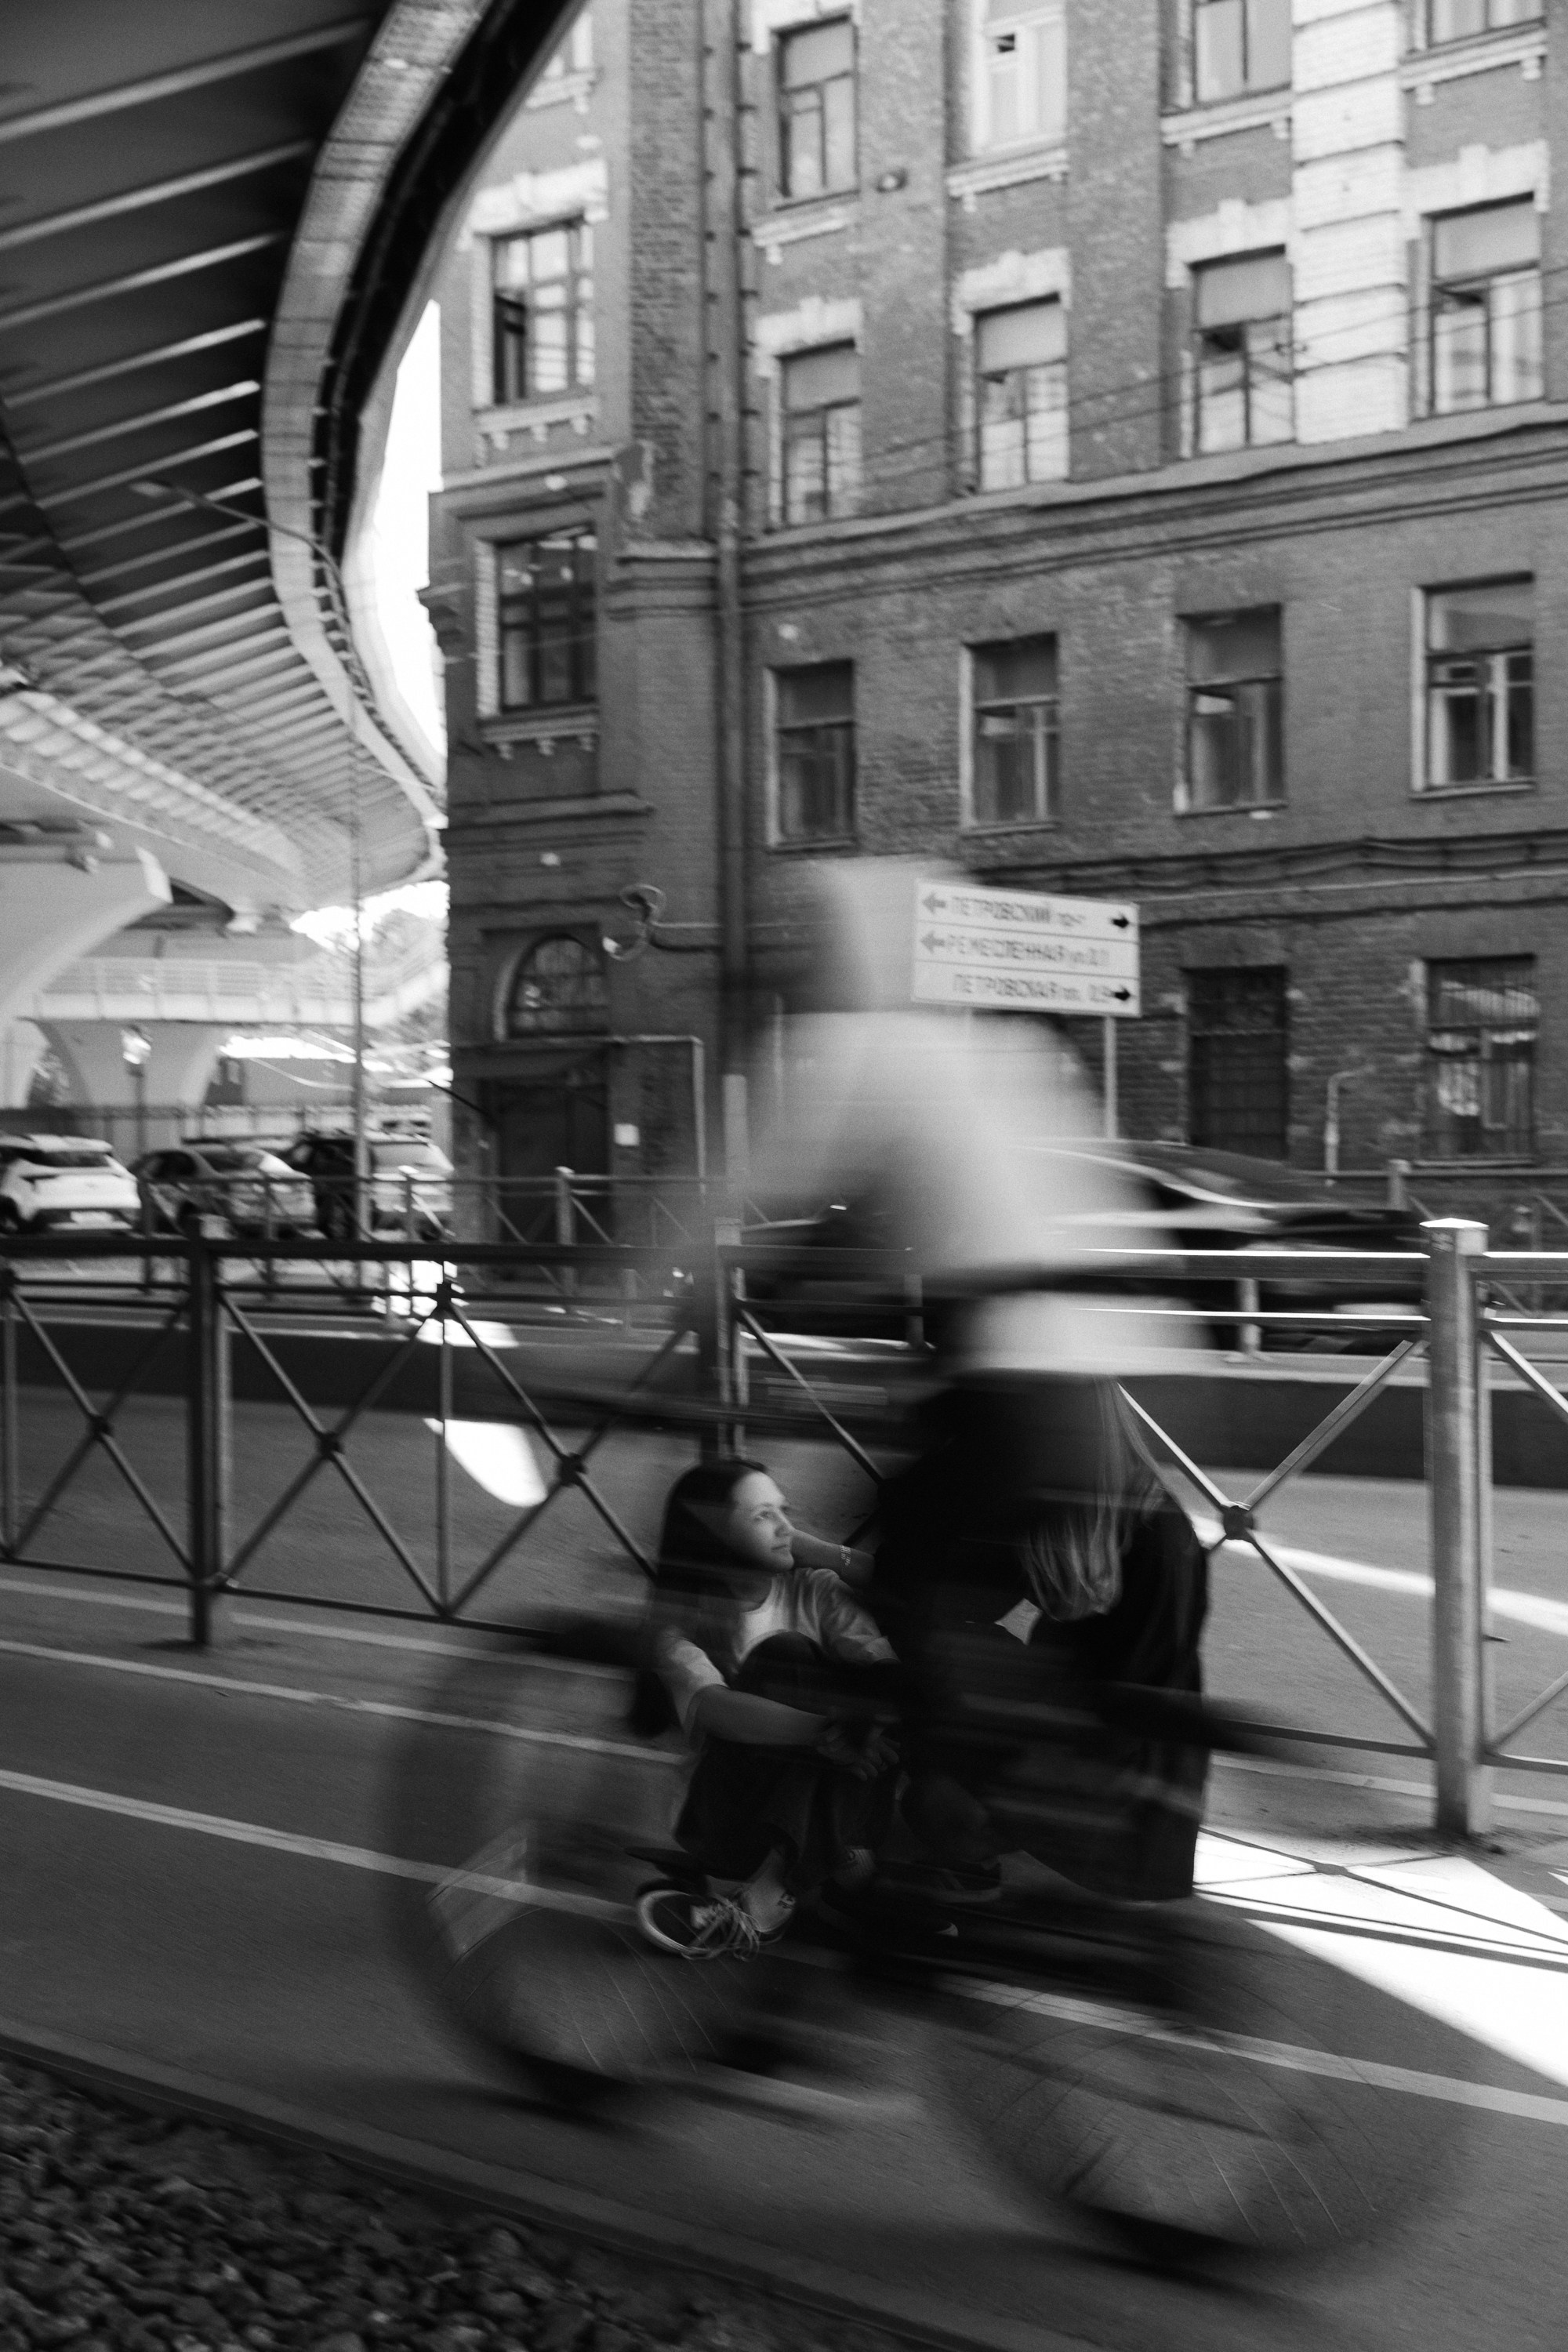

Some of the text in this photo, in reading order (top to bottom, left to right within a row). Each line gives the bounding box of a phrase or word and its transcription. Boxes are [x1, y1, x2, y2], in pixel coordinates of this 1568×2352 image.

[951, 895, 1051, 924] ПЕТРОВСКИЙ
[946, 933, 1065, 964] РЕМЕСЛЕННАЯ
[953, 973, 1058, 1000] ПЕТРОВСКАЯ
